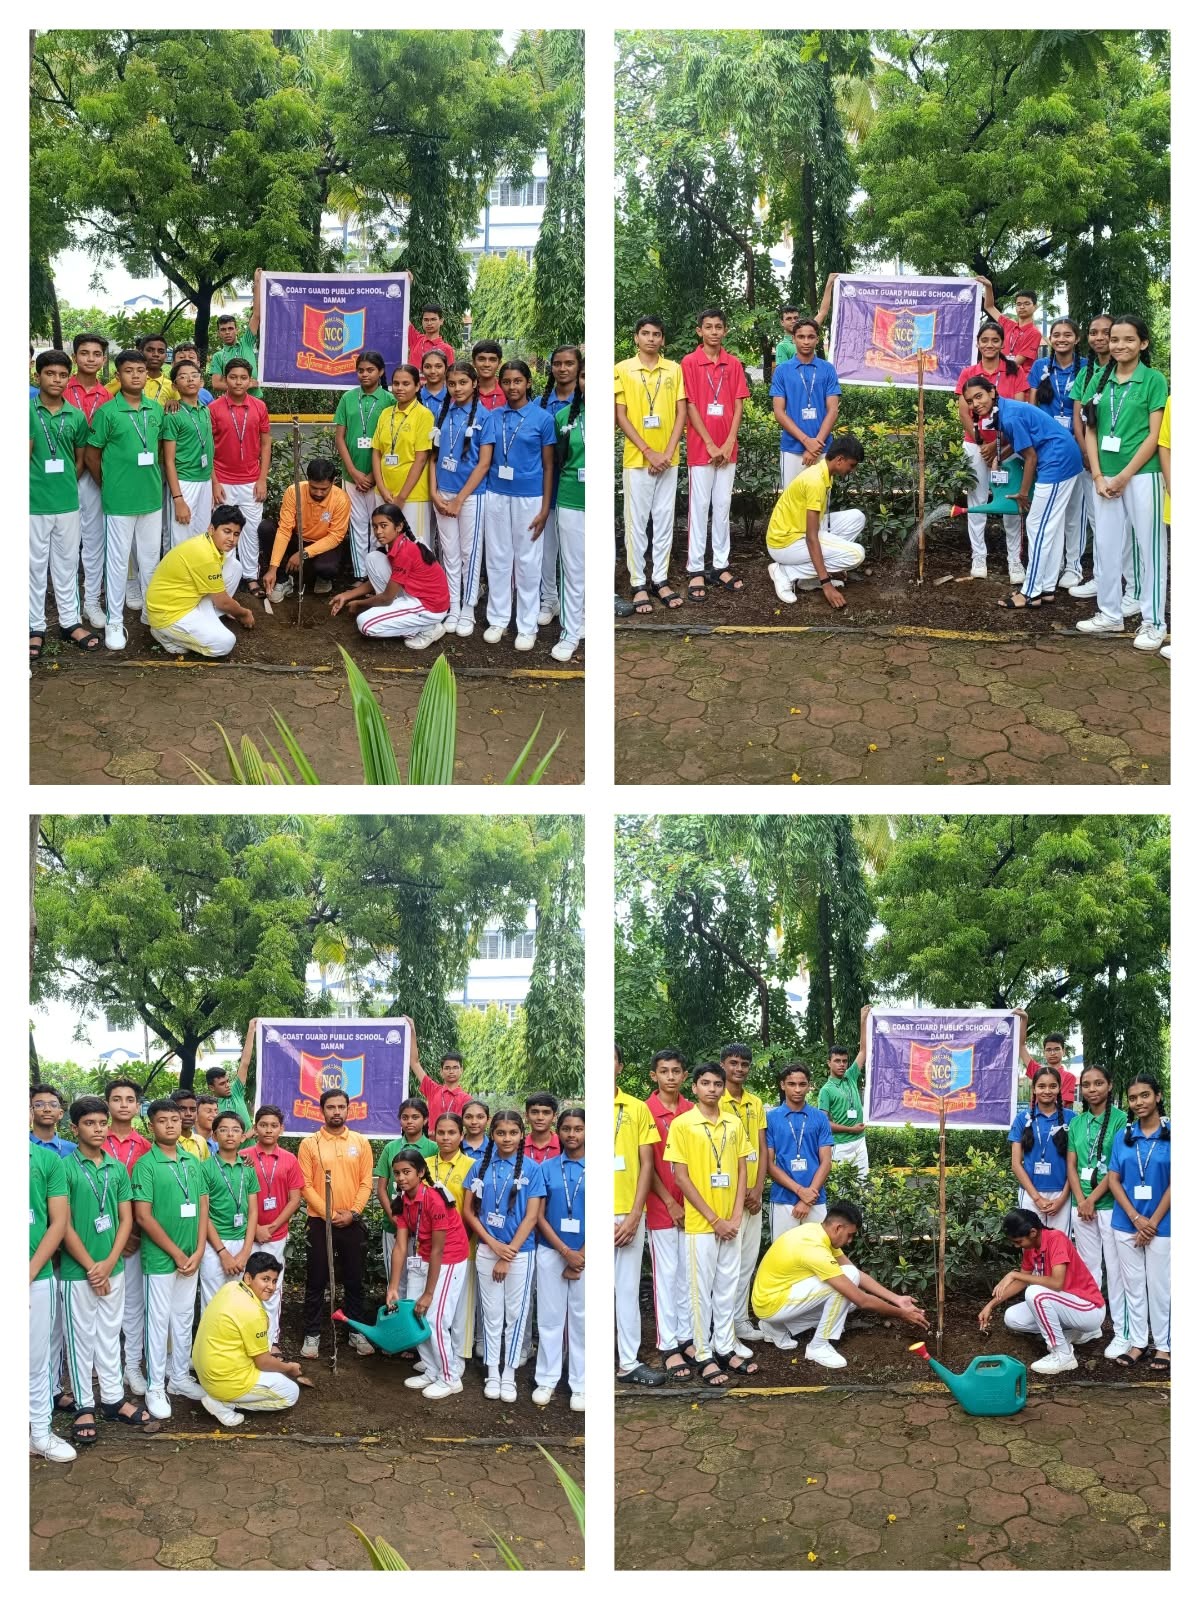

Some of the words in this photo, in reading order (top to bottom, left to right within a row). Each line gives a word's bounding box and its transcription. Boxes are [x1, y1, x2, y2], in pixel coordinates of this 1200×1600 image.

[285, 286, 306, 294] COAST
[331, 287, 355, 295] PUBLIC
[858, 288, 878, 296] COAST
[323, 327, 343, 341] NCC
[894, 328, 913, 342] NCC
[892, 1023, 914, 1031] COAST
[915, 1023, 938, 1031] GUARD
[931, 1064, 951, 1079] NCC
[321, 1074, 341, 1089] NCC
